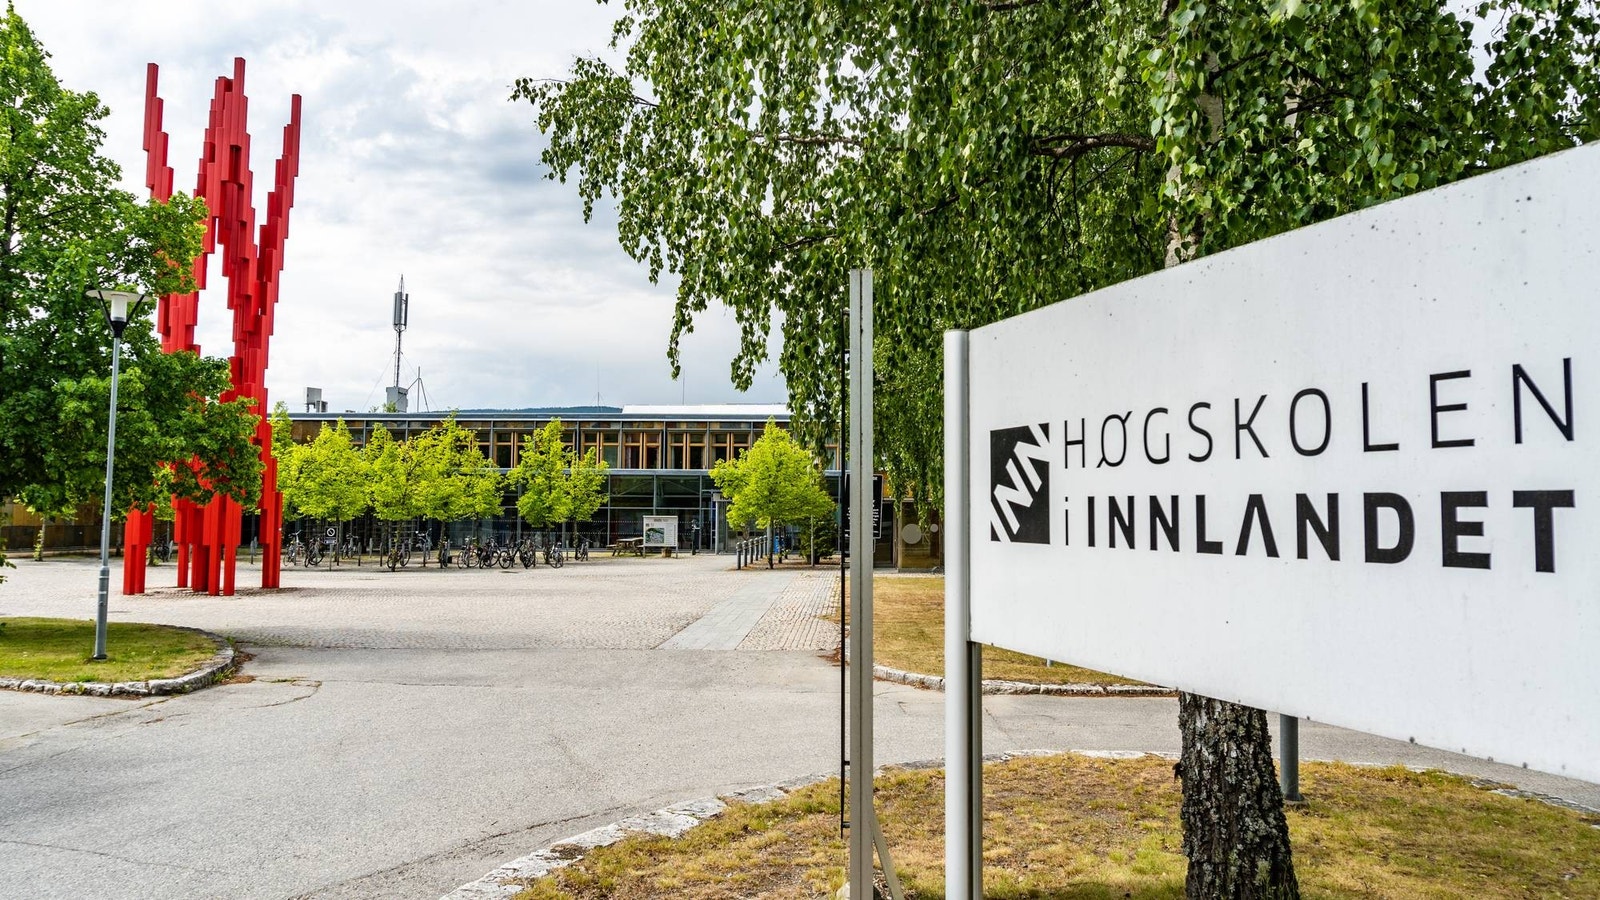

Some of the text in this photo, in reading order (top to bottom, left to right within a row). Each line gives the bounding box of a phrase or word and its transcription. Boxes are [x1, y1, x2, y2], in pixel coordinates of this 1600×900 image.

[1063, 357, 1575, 470] HØGSKOLEN
[1064, 489, 1576, 574] i INNLANDET
